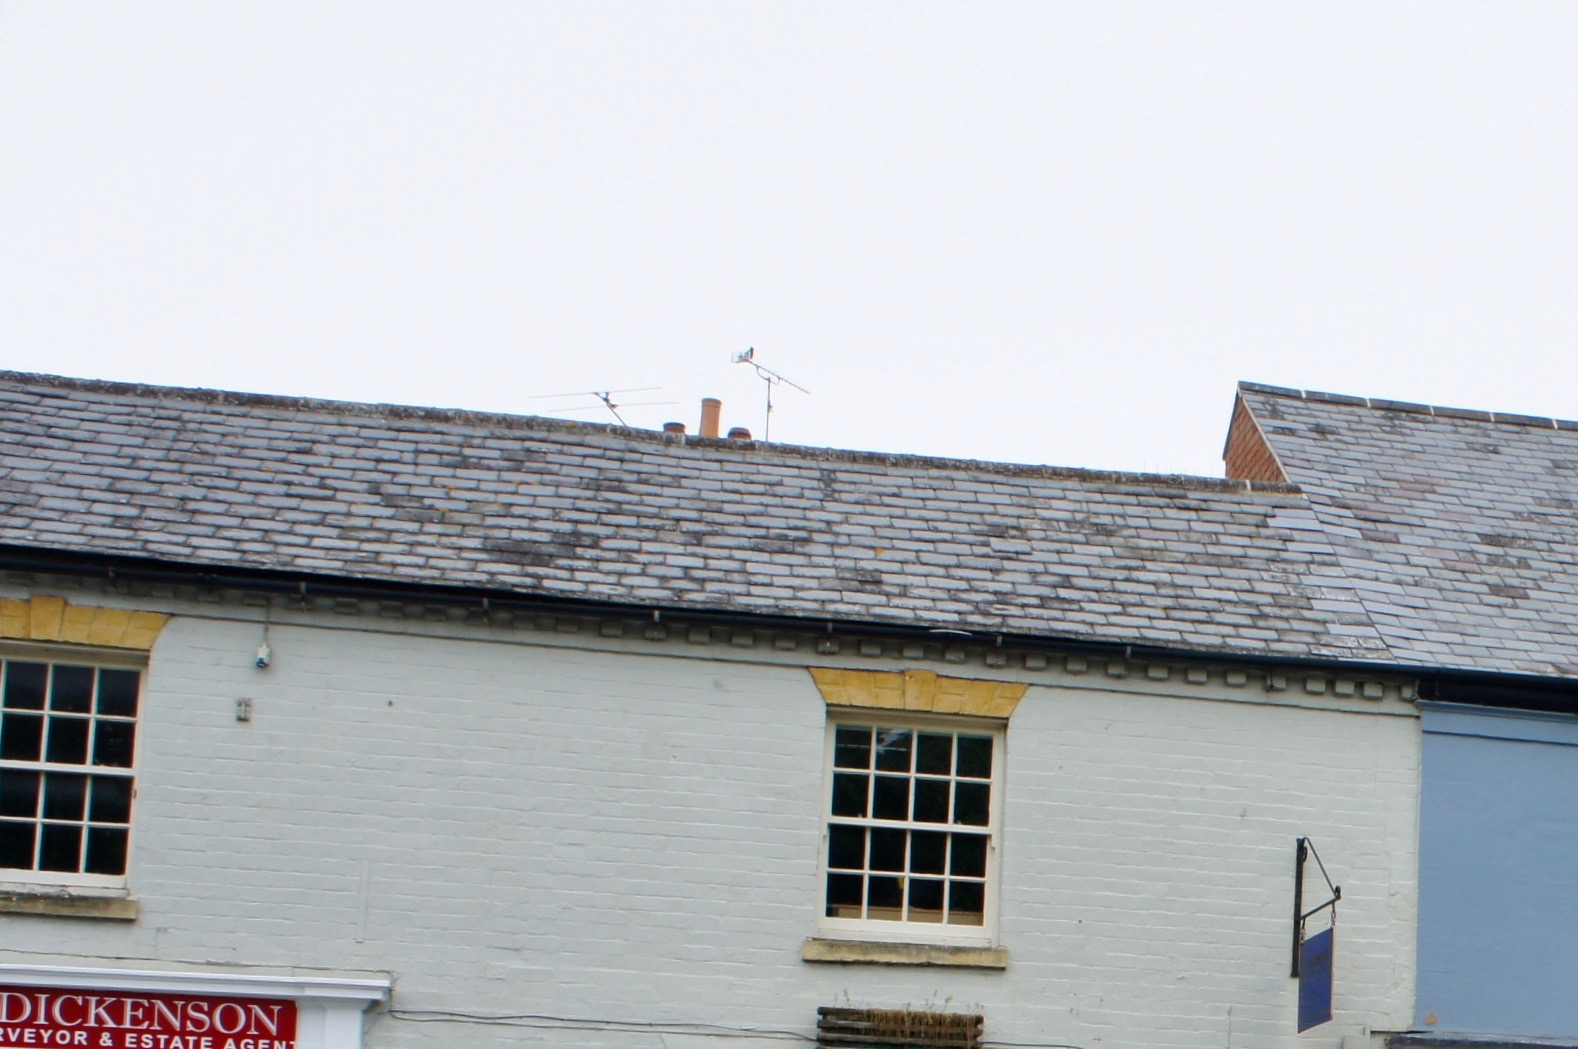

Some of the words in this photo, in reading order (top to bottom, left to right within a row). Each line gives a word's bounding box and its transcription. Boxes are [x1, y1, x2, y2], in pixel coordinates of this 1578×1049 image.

[0, 992, 282, 1036] DICKENSON
[0, 1028, 88, 1046] VEYOR
[99, 1031, 114, 1047] &
